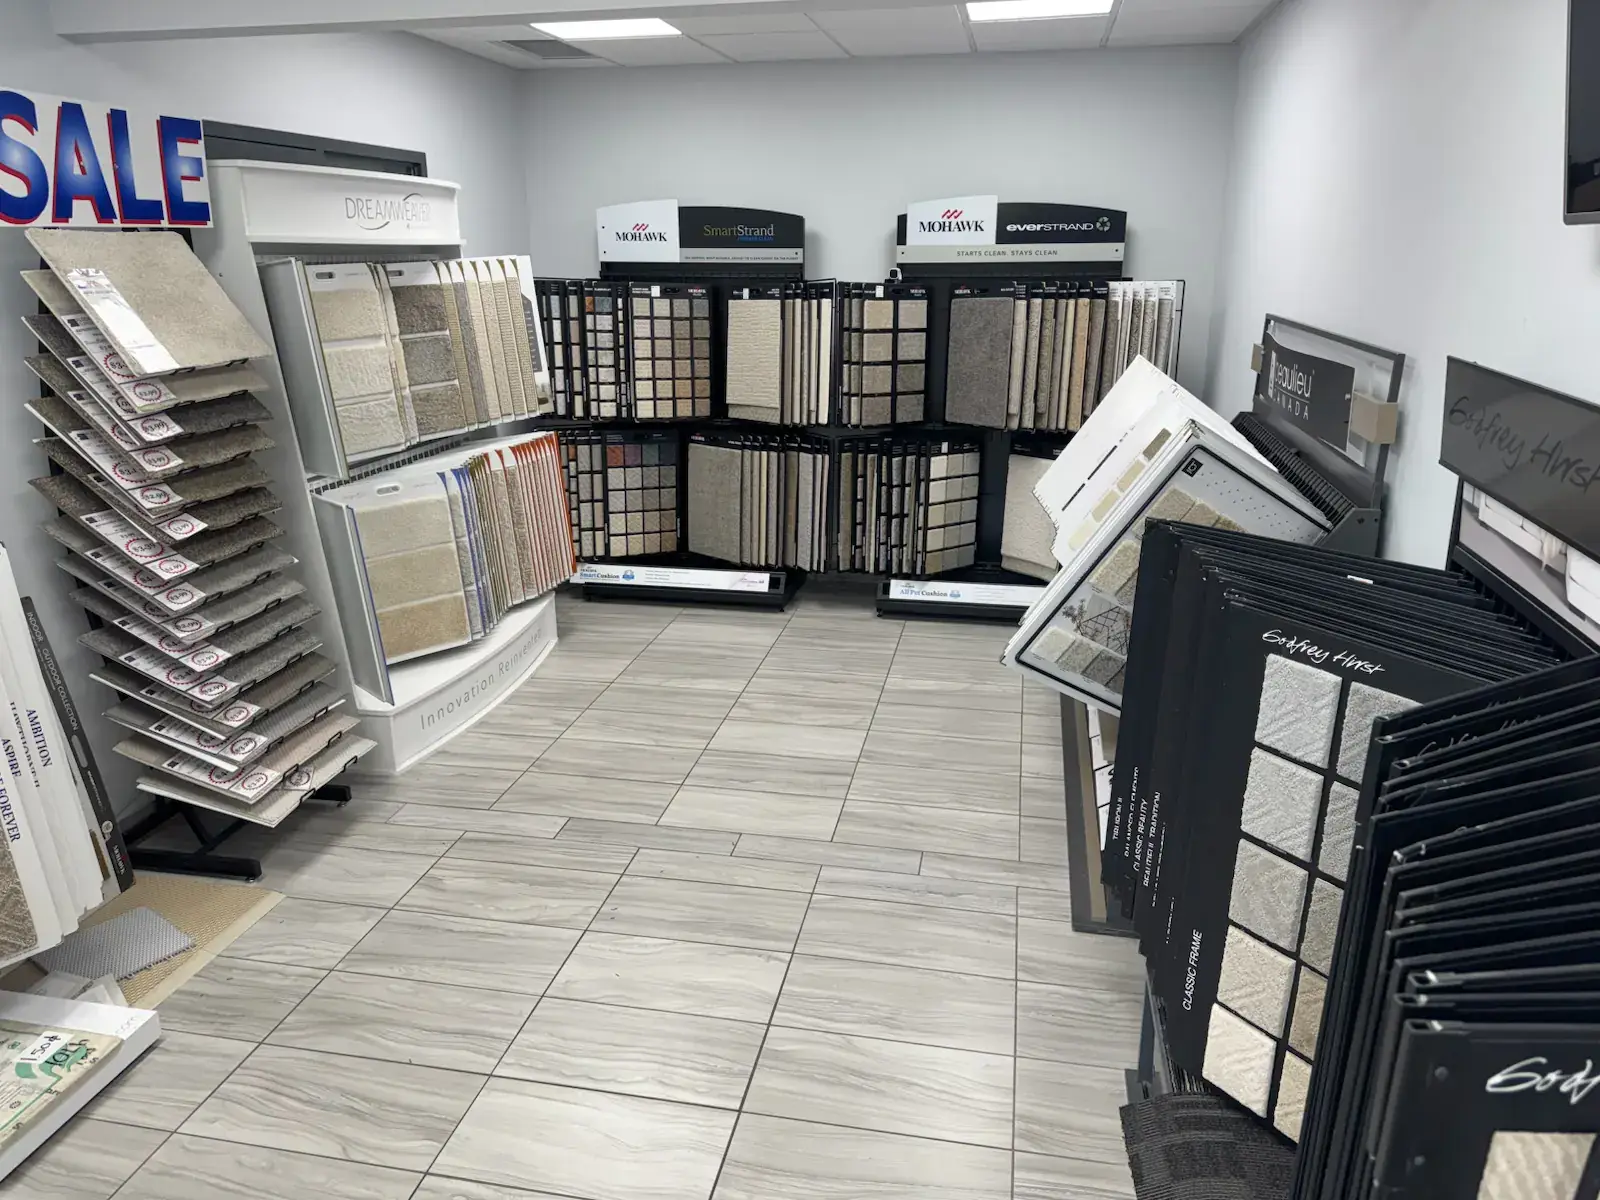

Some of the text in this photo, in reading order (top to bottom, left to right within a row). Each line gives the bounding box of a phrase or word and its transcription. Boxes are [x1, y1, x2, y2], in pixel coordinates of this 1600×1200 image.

[0, 90, 211, 226] SALE
[615, 231, 667, 242] MOHAWK
[703, 224, 774, 237] SmartStrand
[919, 220, 984, 232] MOHAWK
[1006, 223, 1094, 232] everSTRAND
[1273, 388, 1309, 421] ANADA
[1448, 396, 1525, 471] Godfrey
[27, 612, 43, 642] INDOOR
[43, 648, 62, 686] OUTDOOR
[58, 686, 78, 731] COLLECTION
[1262, 629, 1386, 674] Godfrey Hirst
[420, 673, 495, 730] Innovation
[1, 737, 22, 778] ASPIRE
[26, 708, 52, 768] AMBITION
[0, 788, 21, 843] FOREVER
[1149, 791, 1161, 838] TRADITION
[1133, 835, 1144, 872] CLASSIC
[1182, 929, 1203, 1011] CLASSIC FRAME
